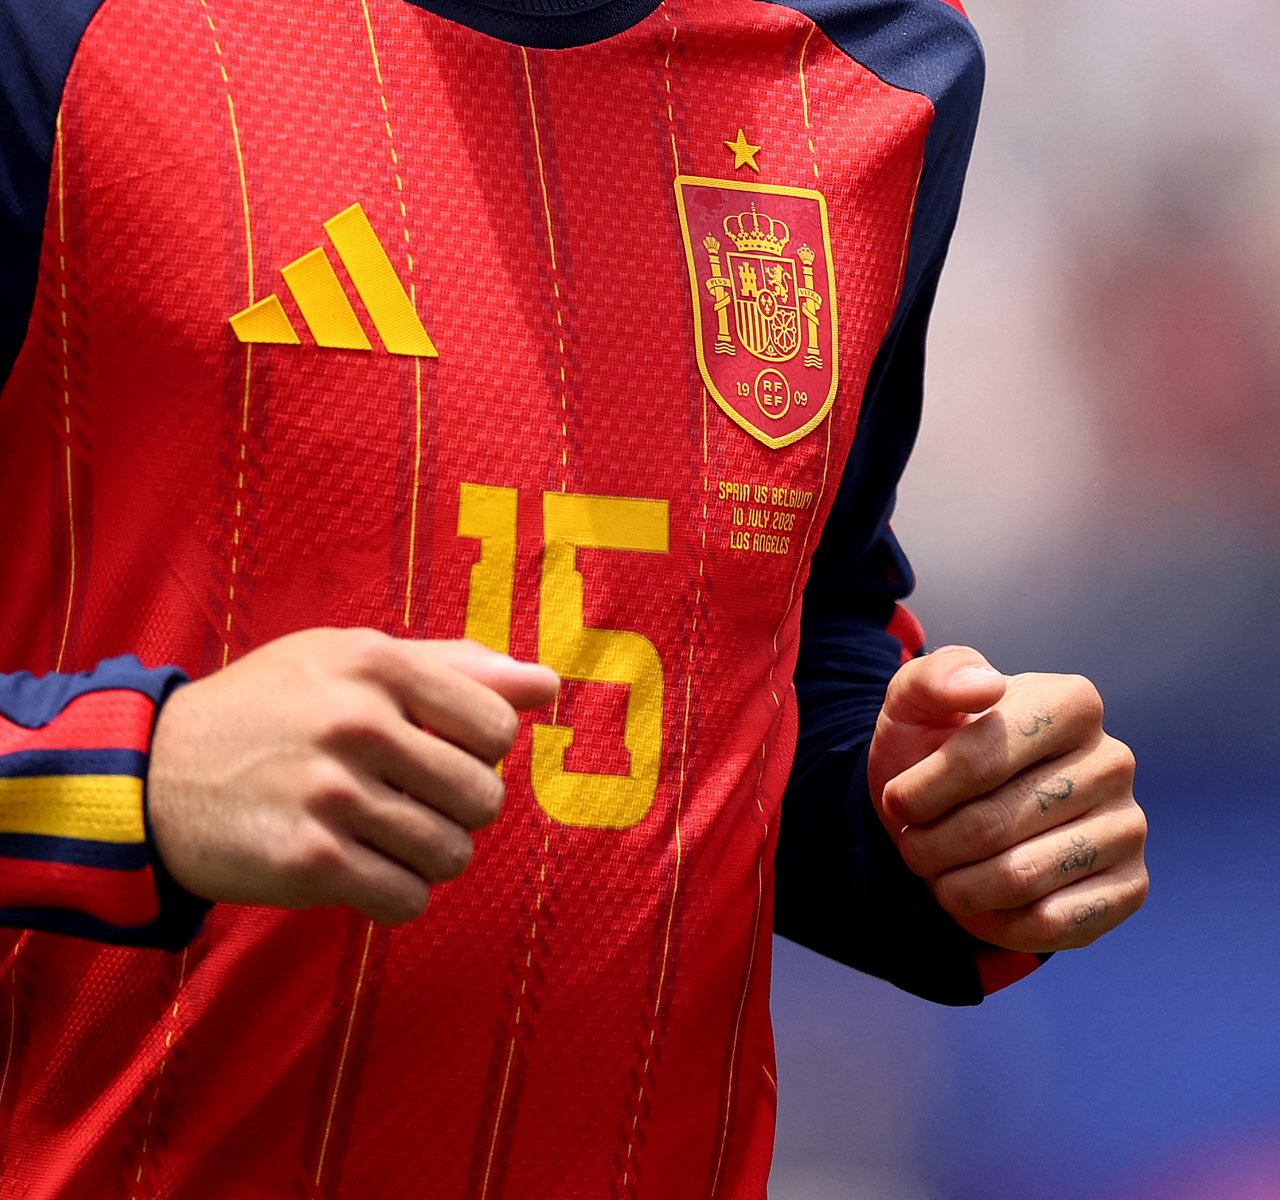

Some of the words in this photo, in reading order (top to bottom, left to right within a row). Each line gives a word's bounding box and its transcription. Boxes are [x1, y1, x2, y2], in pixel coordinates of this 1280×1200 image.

[736, 381, 750, 397] 19
[763, 380, 783, 392] RF
[764, 394, 783, 406] EF
[793, 390, 808, 406] 09
[719, 481, 750, 502] SPAIN
[772, 487, 813, 509] BELGIUM
[732, 506, 744, 526] 10
[746, 508, 771, 528] JULY
[772, 511, 796, 532] 2026
[730, 531, 750, 550] LOS
[752, 533, 790, 555] ANGELES
[457, 482, 670, 830] 15
